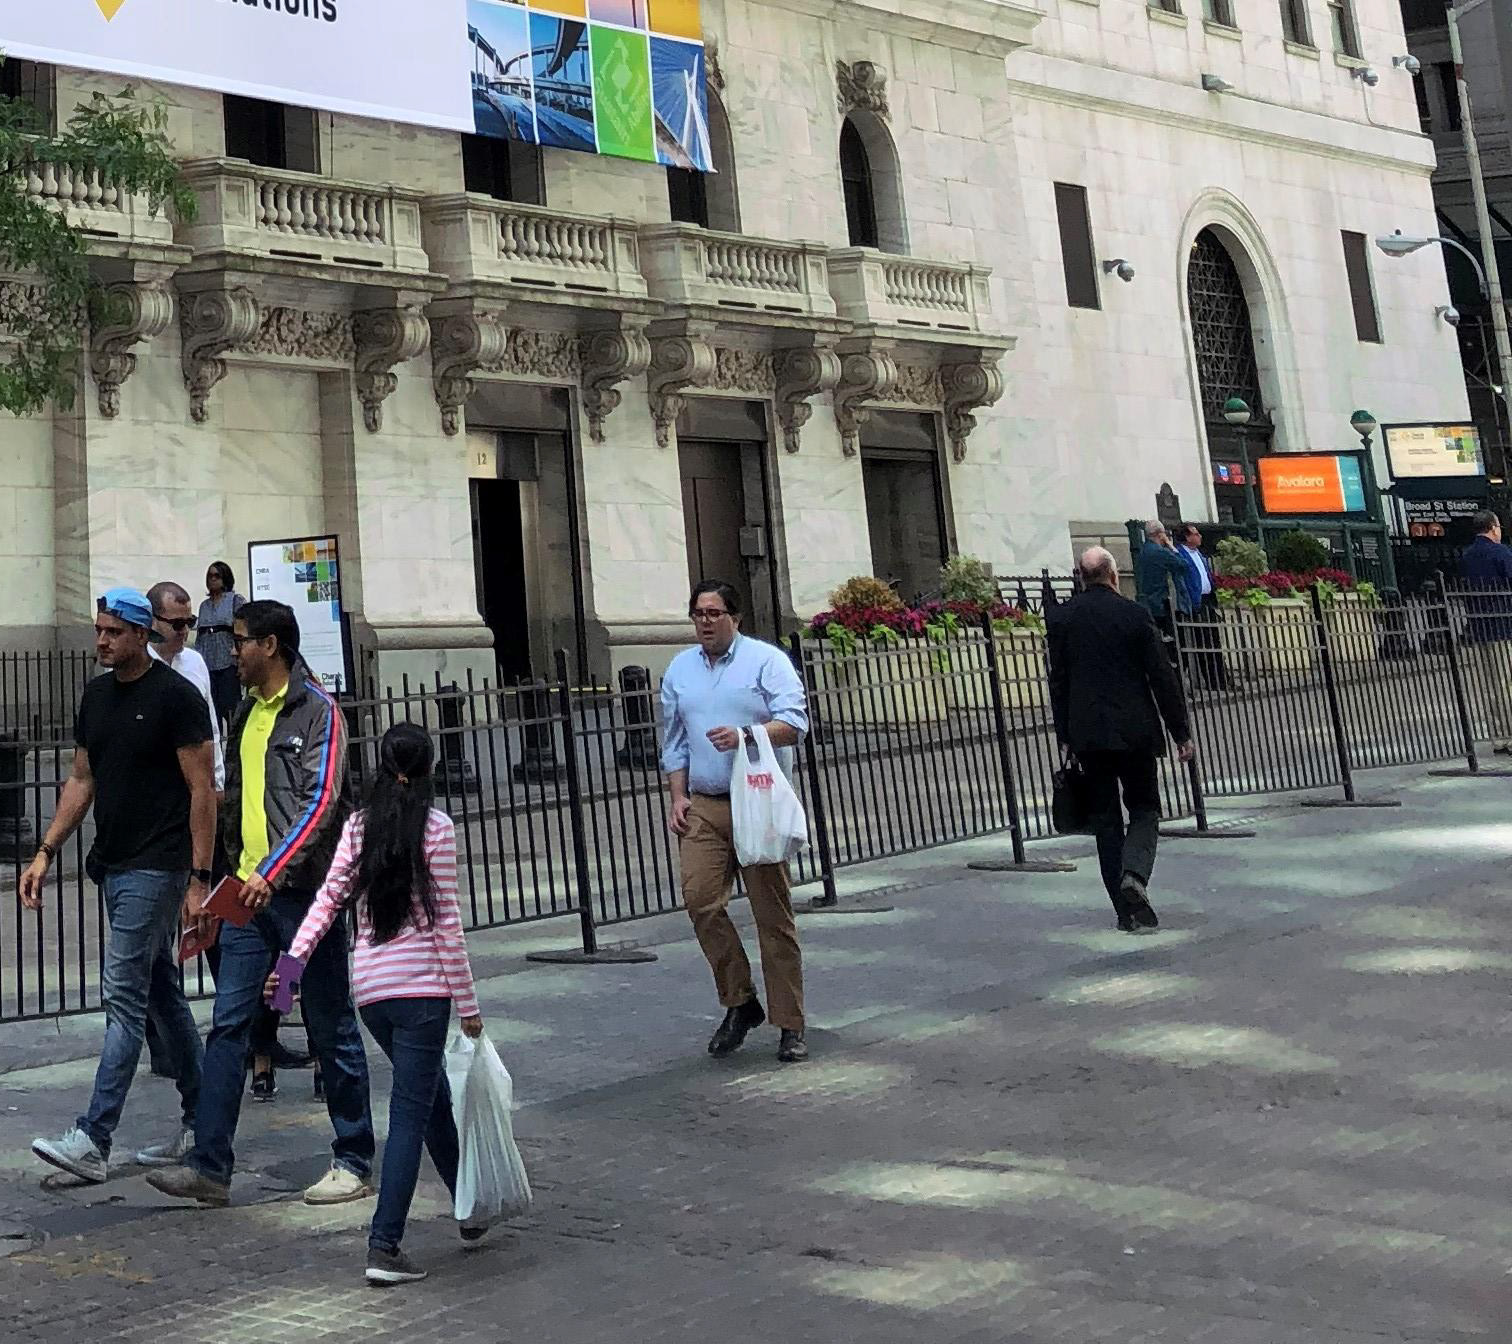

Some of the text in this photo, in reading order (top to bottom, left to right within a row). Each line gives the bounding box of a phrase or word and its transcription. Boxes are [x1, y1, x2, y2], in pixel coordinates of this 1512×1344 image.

[477, 452, 487, 465] 12
[1405, 500, 1478, 510] Broad St Station
